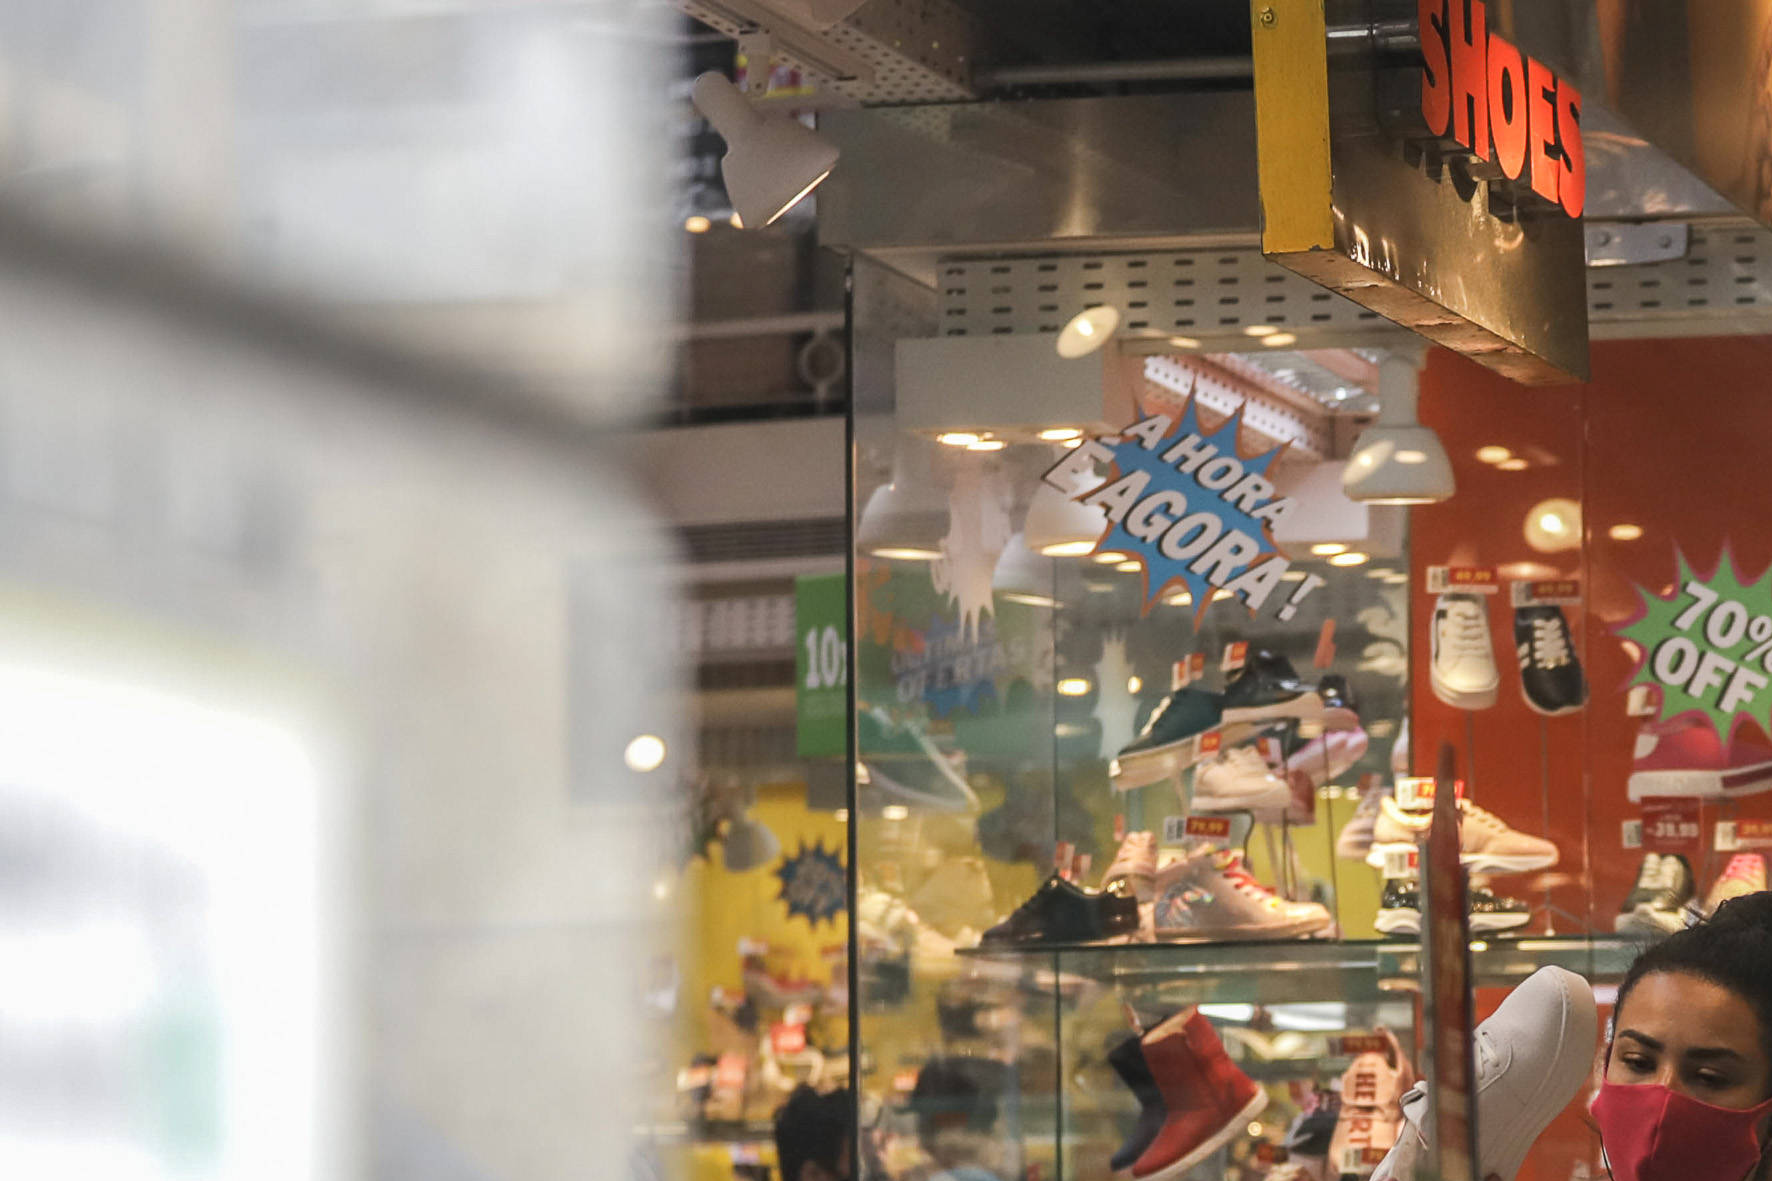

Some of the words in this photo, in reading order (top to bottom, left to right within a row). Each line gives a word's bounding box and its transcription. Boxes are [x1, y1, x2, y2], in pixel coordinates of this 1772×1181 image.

[1418, 0, 1585, 219] SHOES
[1119, 413, 1173, 450] A
[1158, 433, 1295, 533] HORA
[1081, 470, 1327, 622] AGORA!
[1650, 637, 1769, 713] OFF
